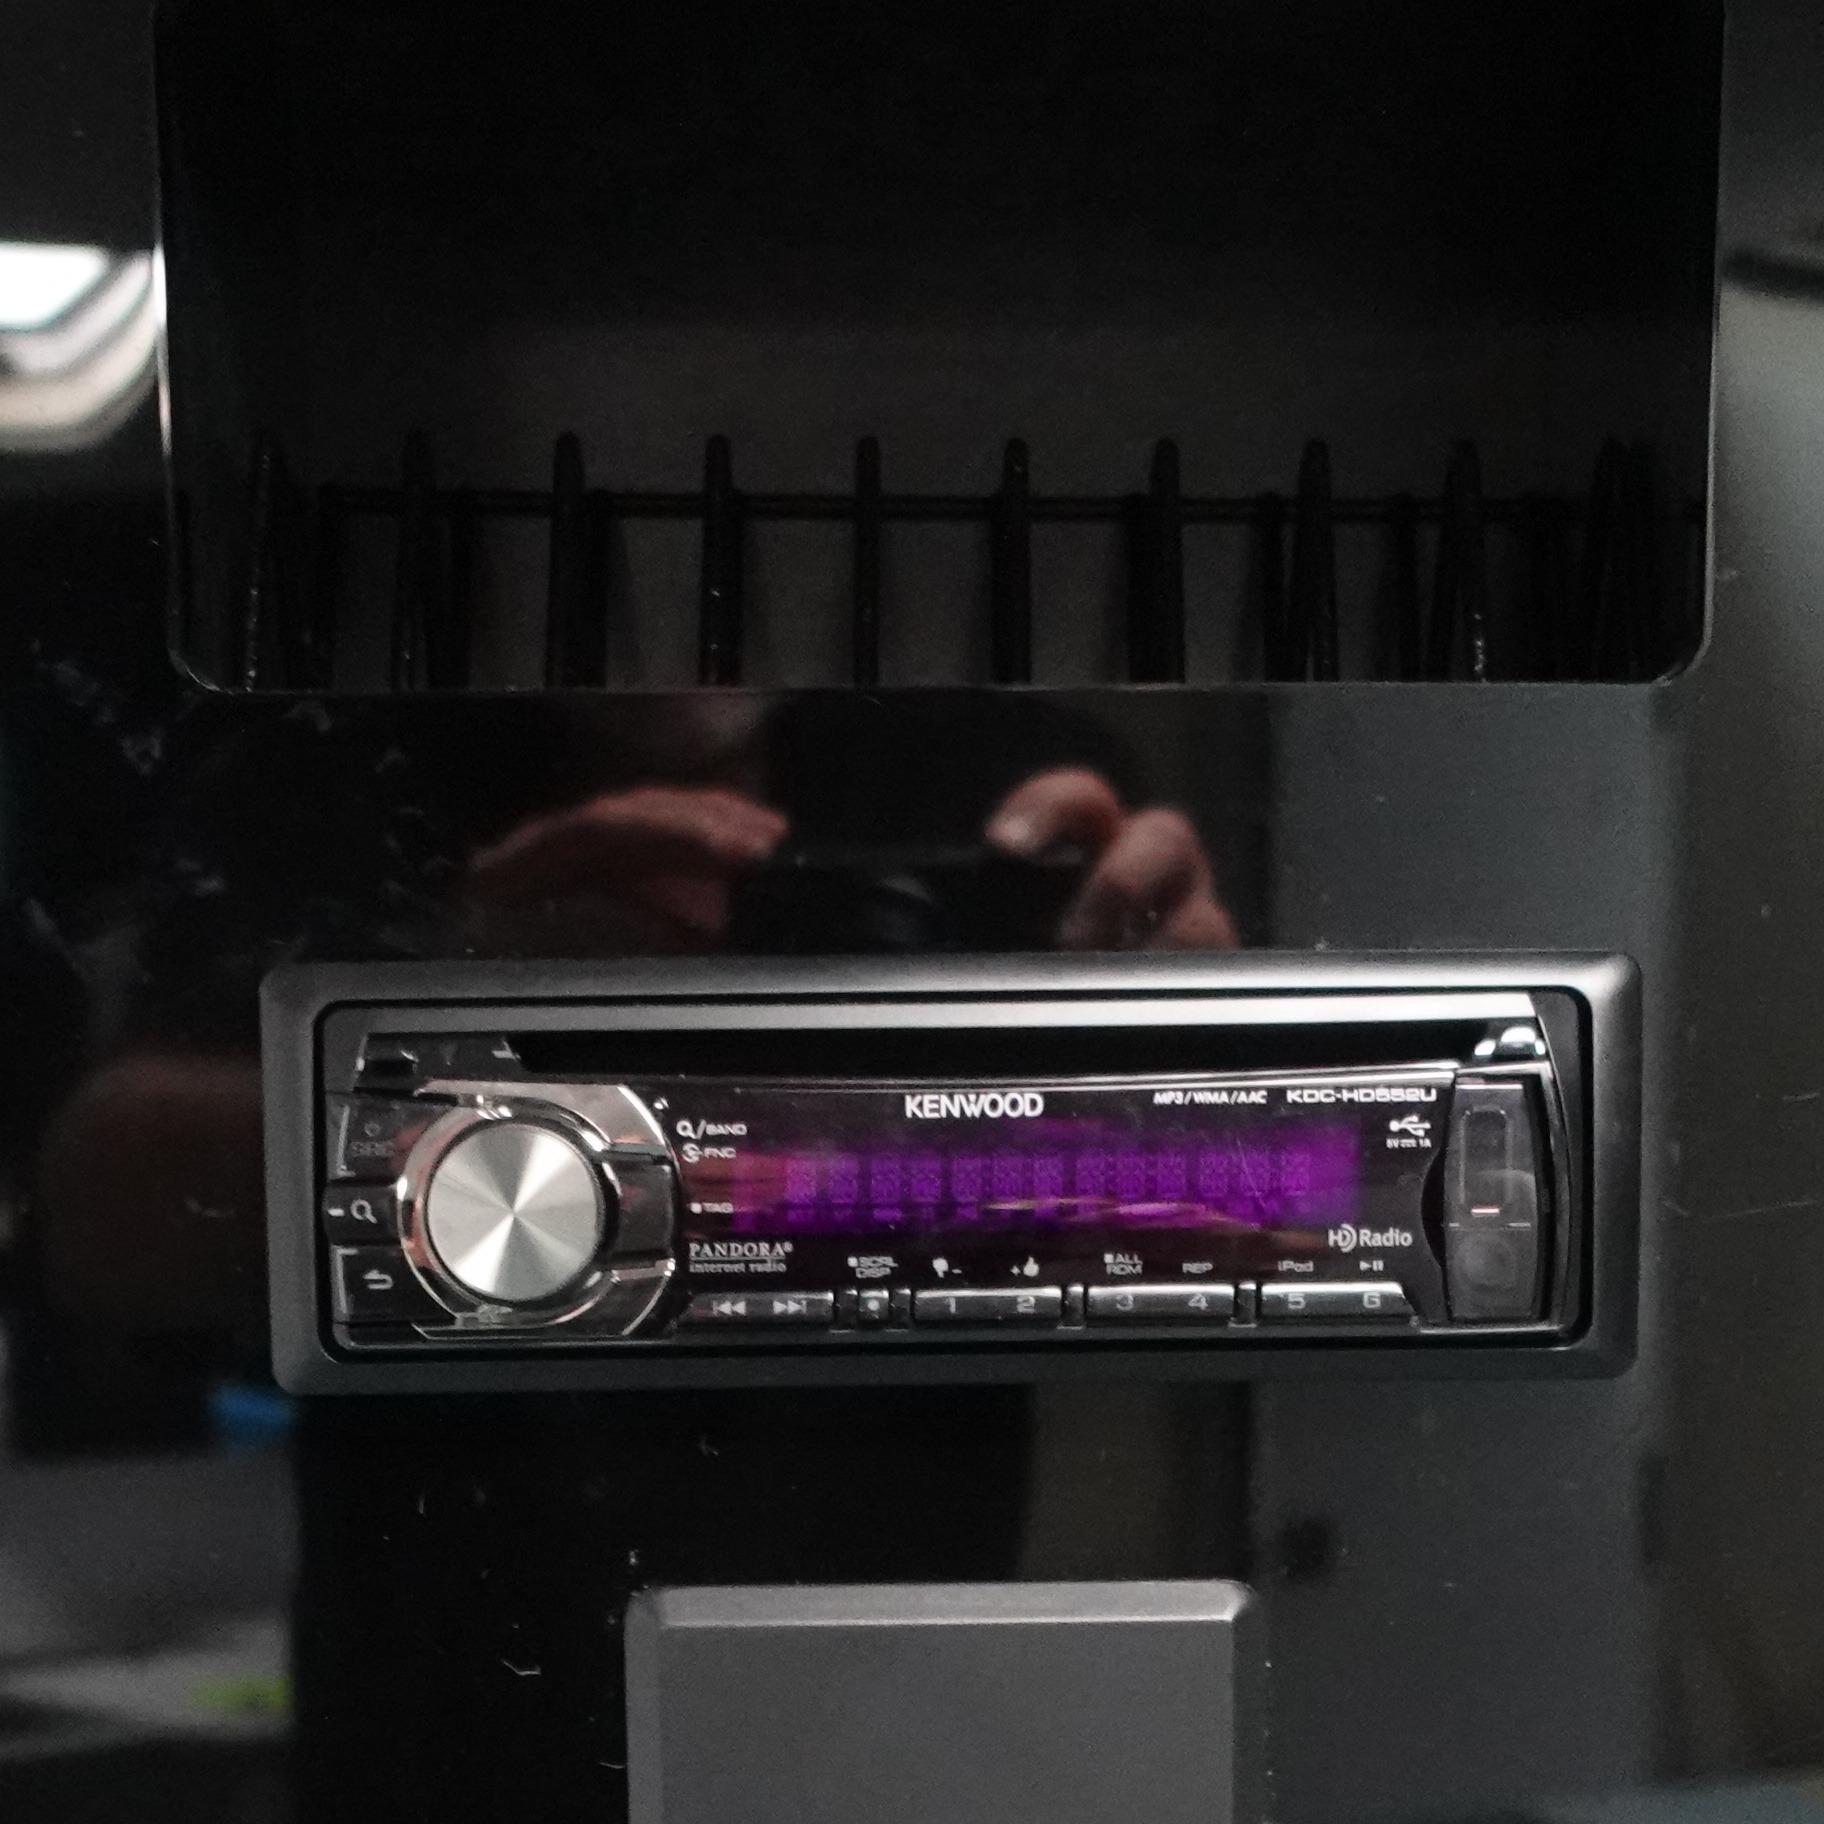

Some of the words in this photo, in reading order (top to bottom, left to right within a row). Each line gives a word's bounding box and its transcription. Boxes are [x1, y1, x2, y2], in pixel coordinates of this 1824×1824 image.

[904, 1092, 1045, 1119] KENWOOD
[703, 1147, 737, 1159] FNC
[1359, 1227, 1414, 1248] Radio
[1114, 1252, 1143, 1264] ALL
[1277, 1259, 1315, 1273] iPod
[688, 1261, 746, 1274] internet
[749, 1260, 787, 1273] radio
[1106, 1262, 1143, 1276] RDM
[1182, 1261, 1214, 1274] REP
[1015, 1296, 1036, 1314] 2
[1115, 1294, 1134, 1312] 3
[1188, 1293, 1209, 1310] 4
[1287, 1293, 1307, 1310] 5
[1362, 1292, 1382, 1309] 6
